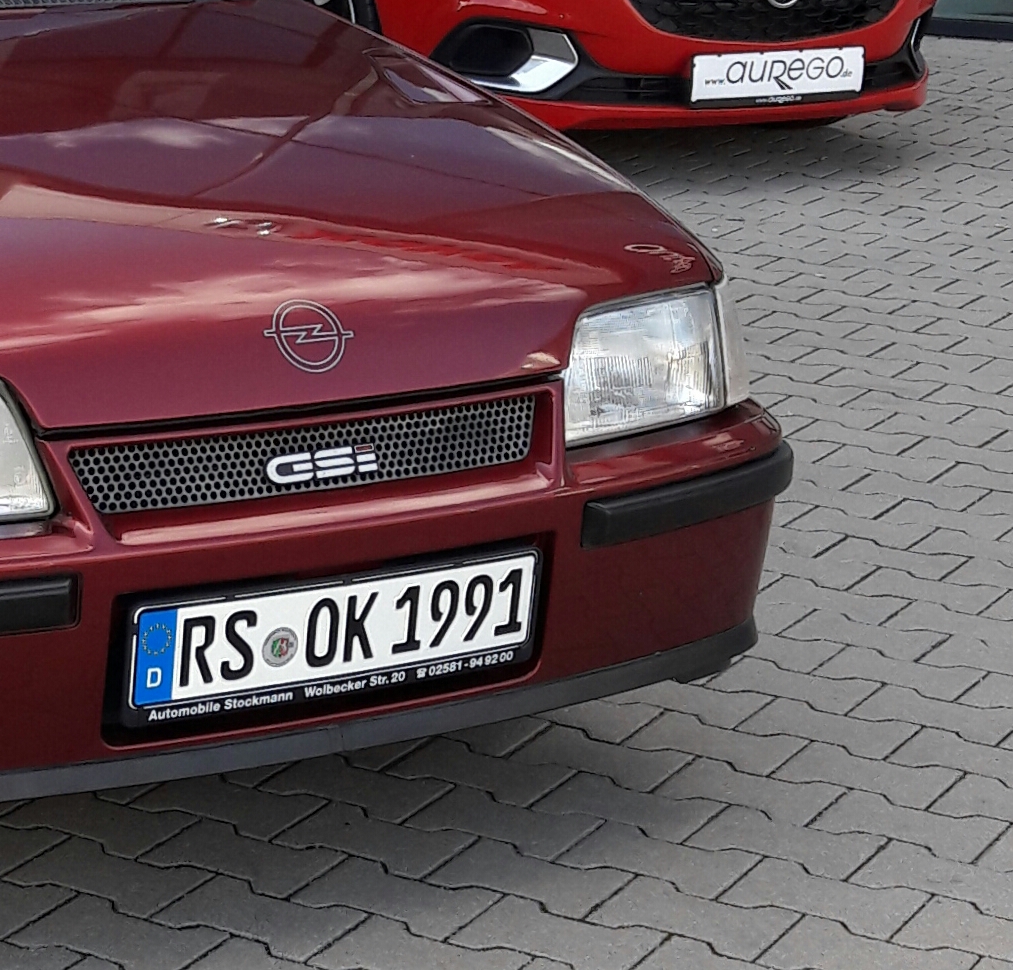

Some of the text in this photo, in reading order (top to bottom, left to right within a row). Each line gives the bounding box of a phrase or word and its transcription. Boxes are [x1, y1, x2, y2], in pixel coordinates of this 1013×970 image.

[146, 568, 523, 688] D RS OK 1991
[148, 701, 221, 722] Automobile
[223, 691, 294, 711] Stockmann
[304, 679, 367, 698] Wolbecker
